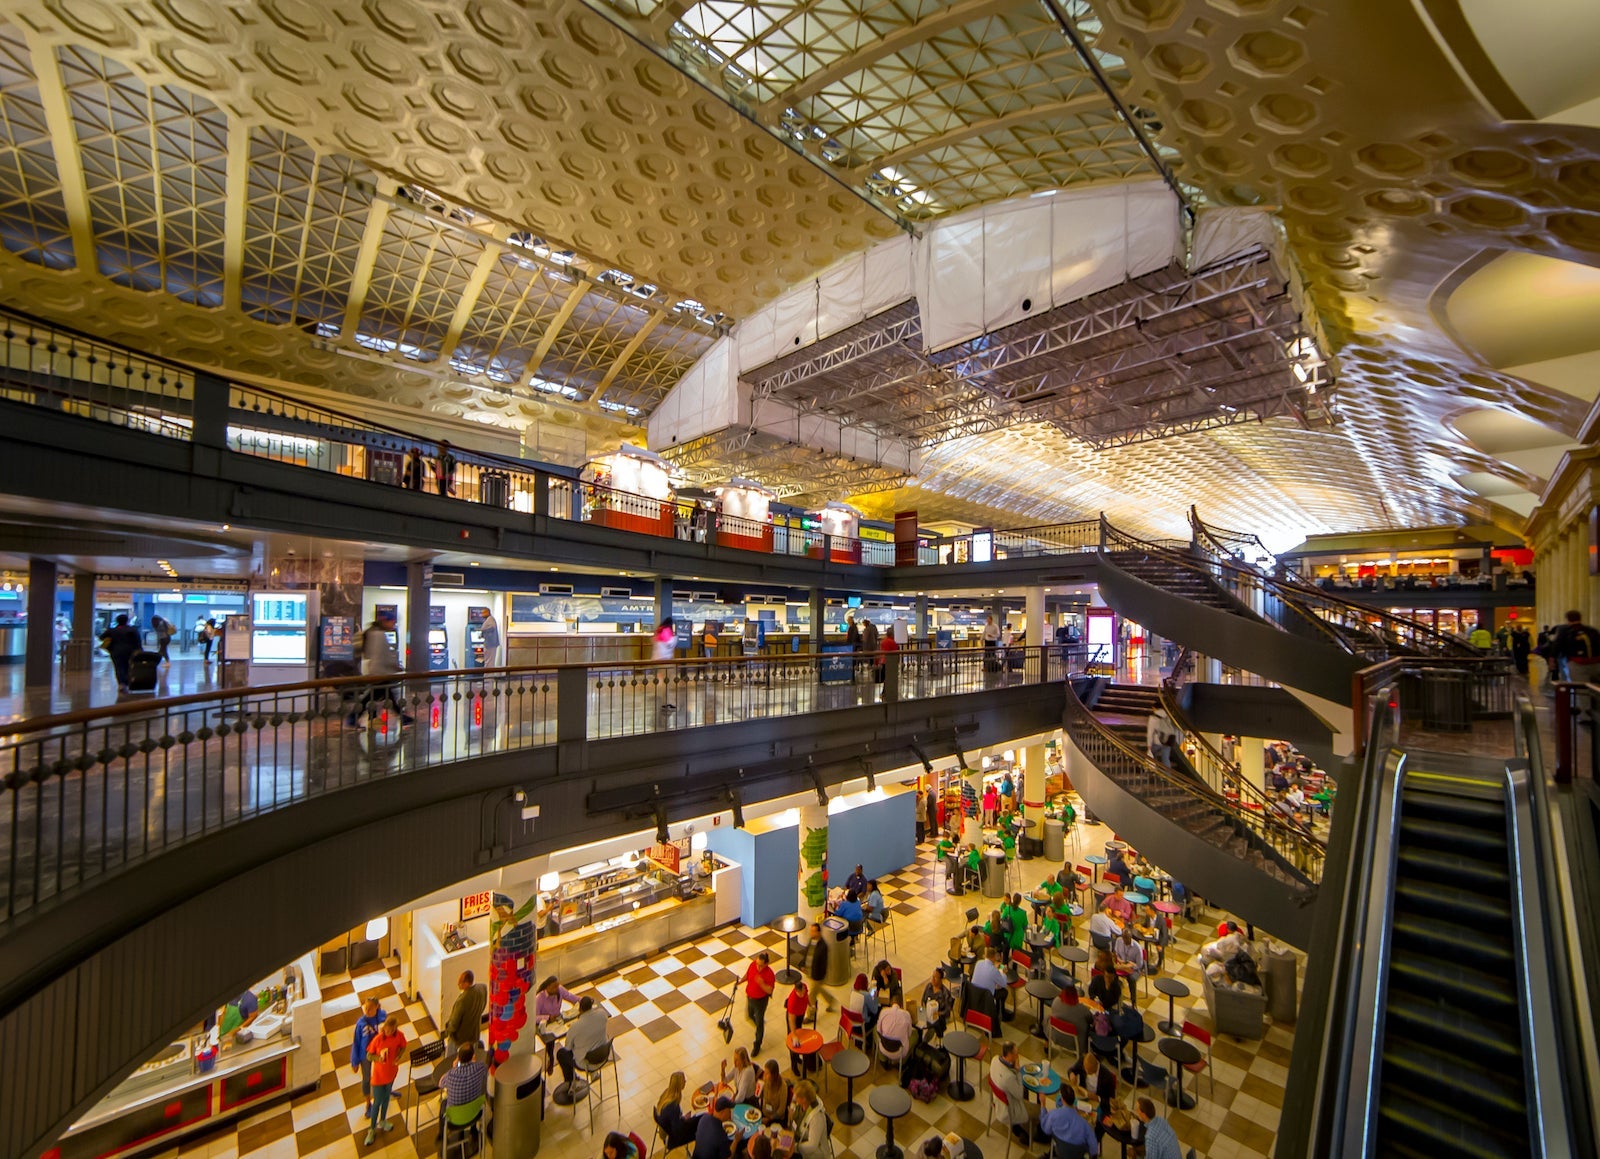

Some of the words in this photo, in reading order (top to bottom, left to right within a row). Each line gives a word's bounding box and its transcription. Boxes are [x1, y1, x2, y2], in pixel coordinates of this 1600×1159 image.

[236, 433, 325, 458] CLOTHIERS
[621, 604, 654, 612] AMTR
[464, 892, 490, 909] FRIES
